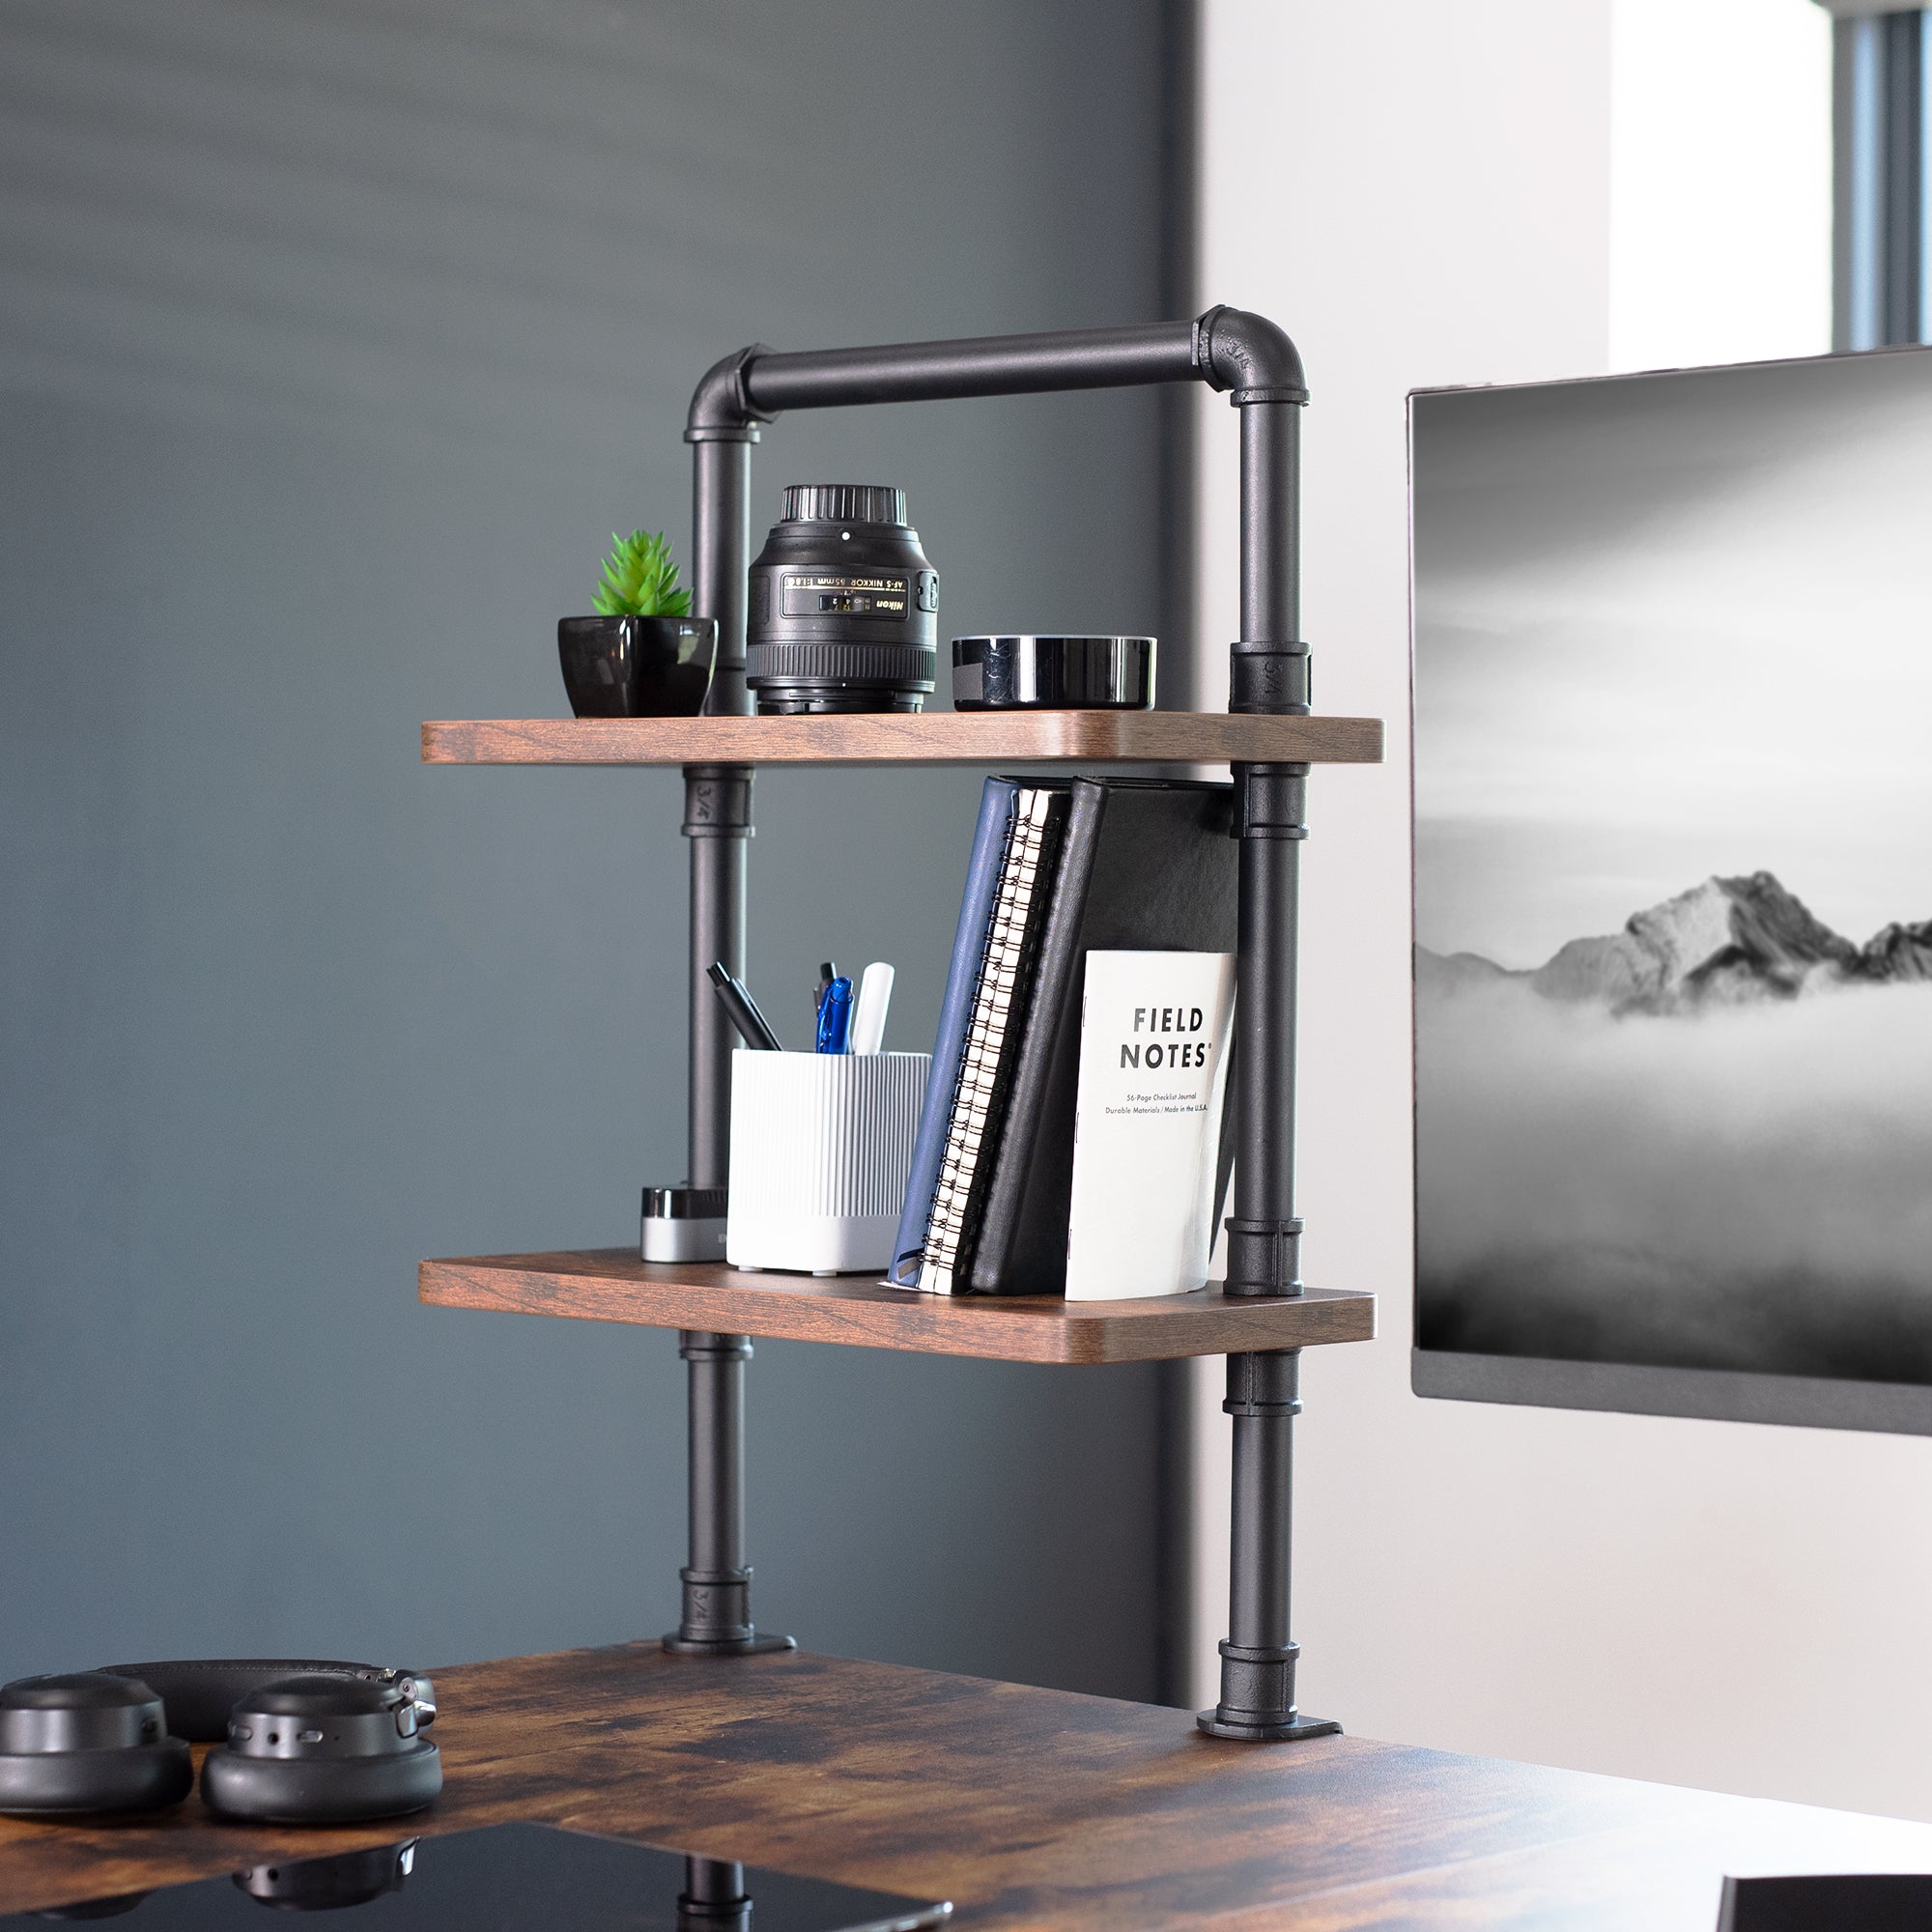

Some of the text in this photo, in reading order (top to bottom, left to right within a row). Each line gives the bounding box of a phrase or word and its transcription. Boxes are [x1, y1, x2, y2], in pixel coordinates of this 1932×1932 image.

[851, 579, 883, 587] NIKKOR
[886, 580, 903, 588] AF-S
[876, 600, 904, 611] Nikon
[696, 785, 712, 820] 3/4
[1133, 1008, 1204, 1033] FIELD
[1120, 1043, 1206, 1069] NOTES
